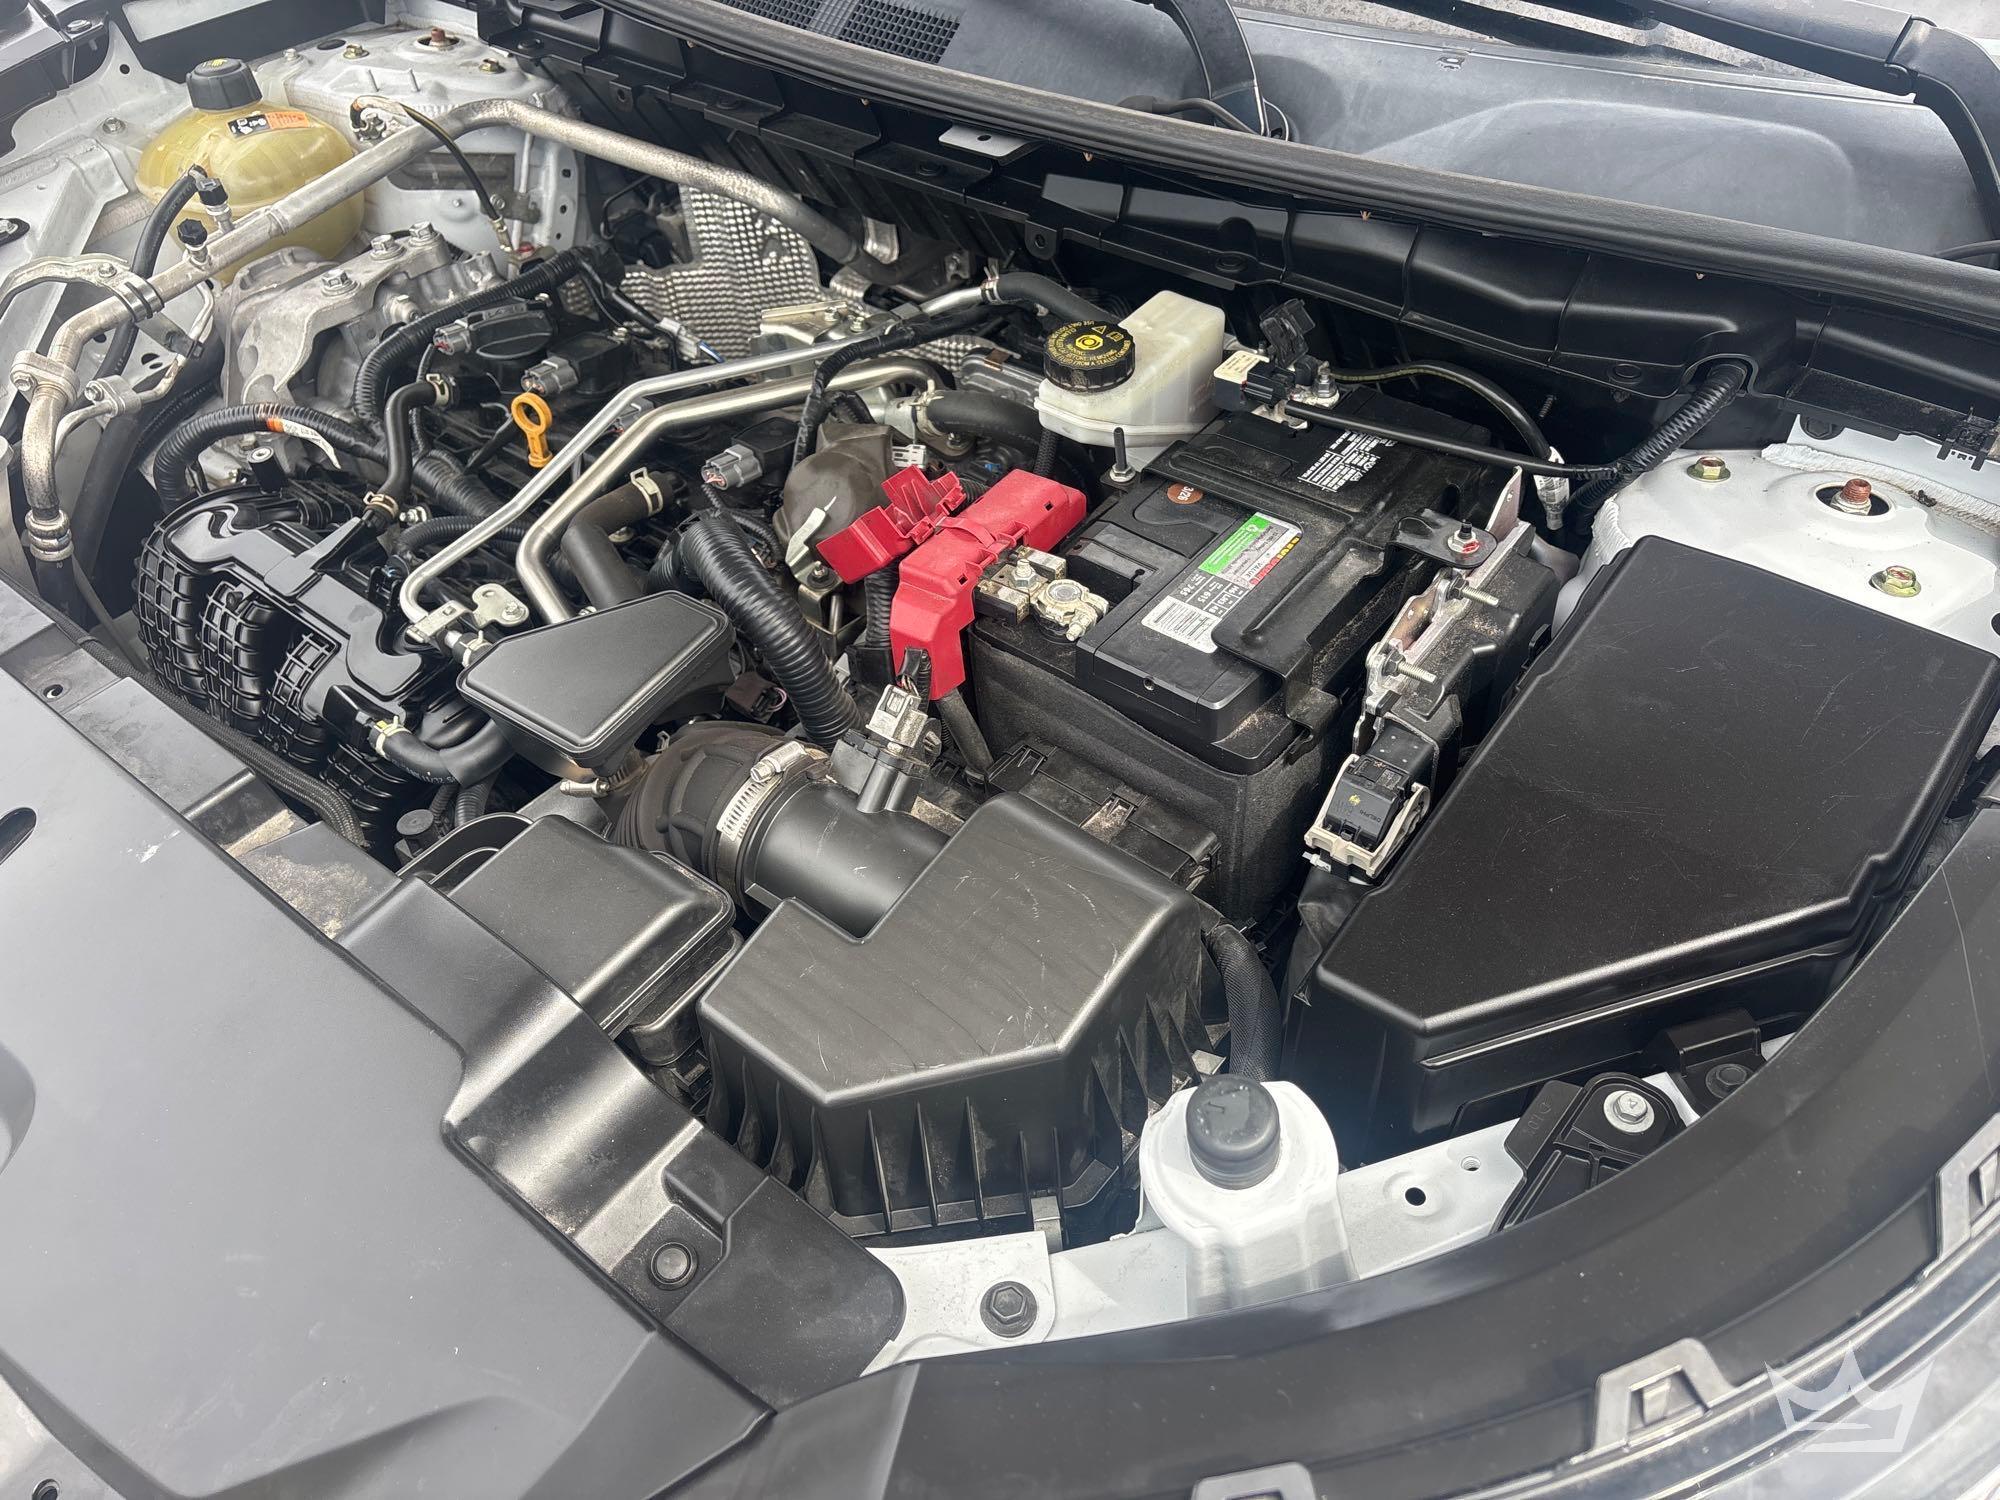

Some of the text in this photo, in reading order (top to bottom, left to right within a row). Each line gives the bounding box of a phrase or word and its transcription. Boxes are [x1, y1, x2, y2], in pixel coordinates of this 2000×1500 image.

[1177, 486, 1194, 501] 3/26
[1245, 562, 1263, 578] VALUE
[1180, 583, 1195, 597] 765
[1197, 591, 1212, 603] 615
